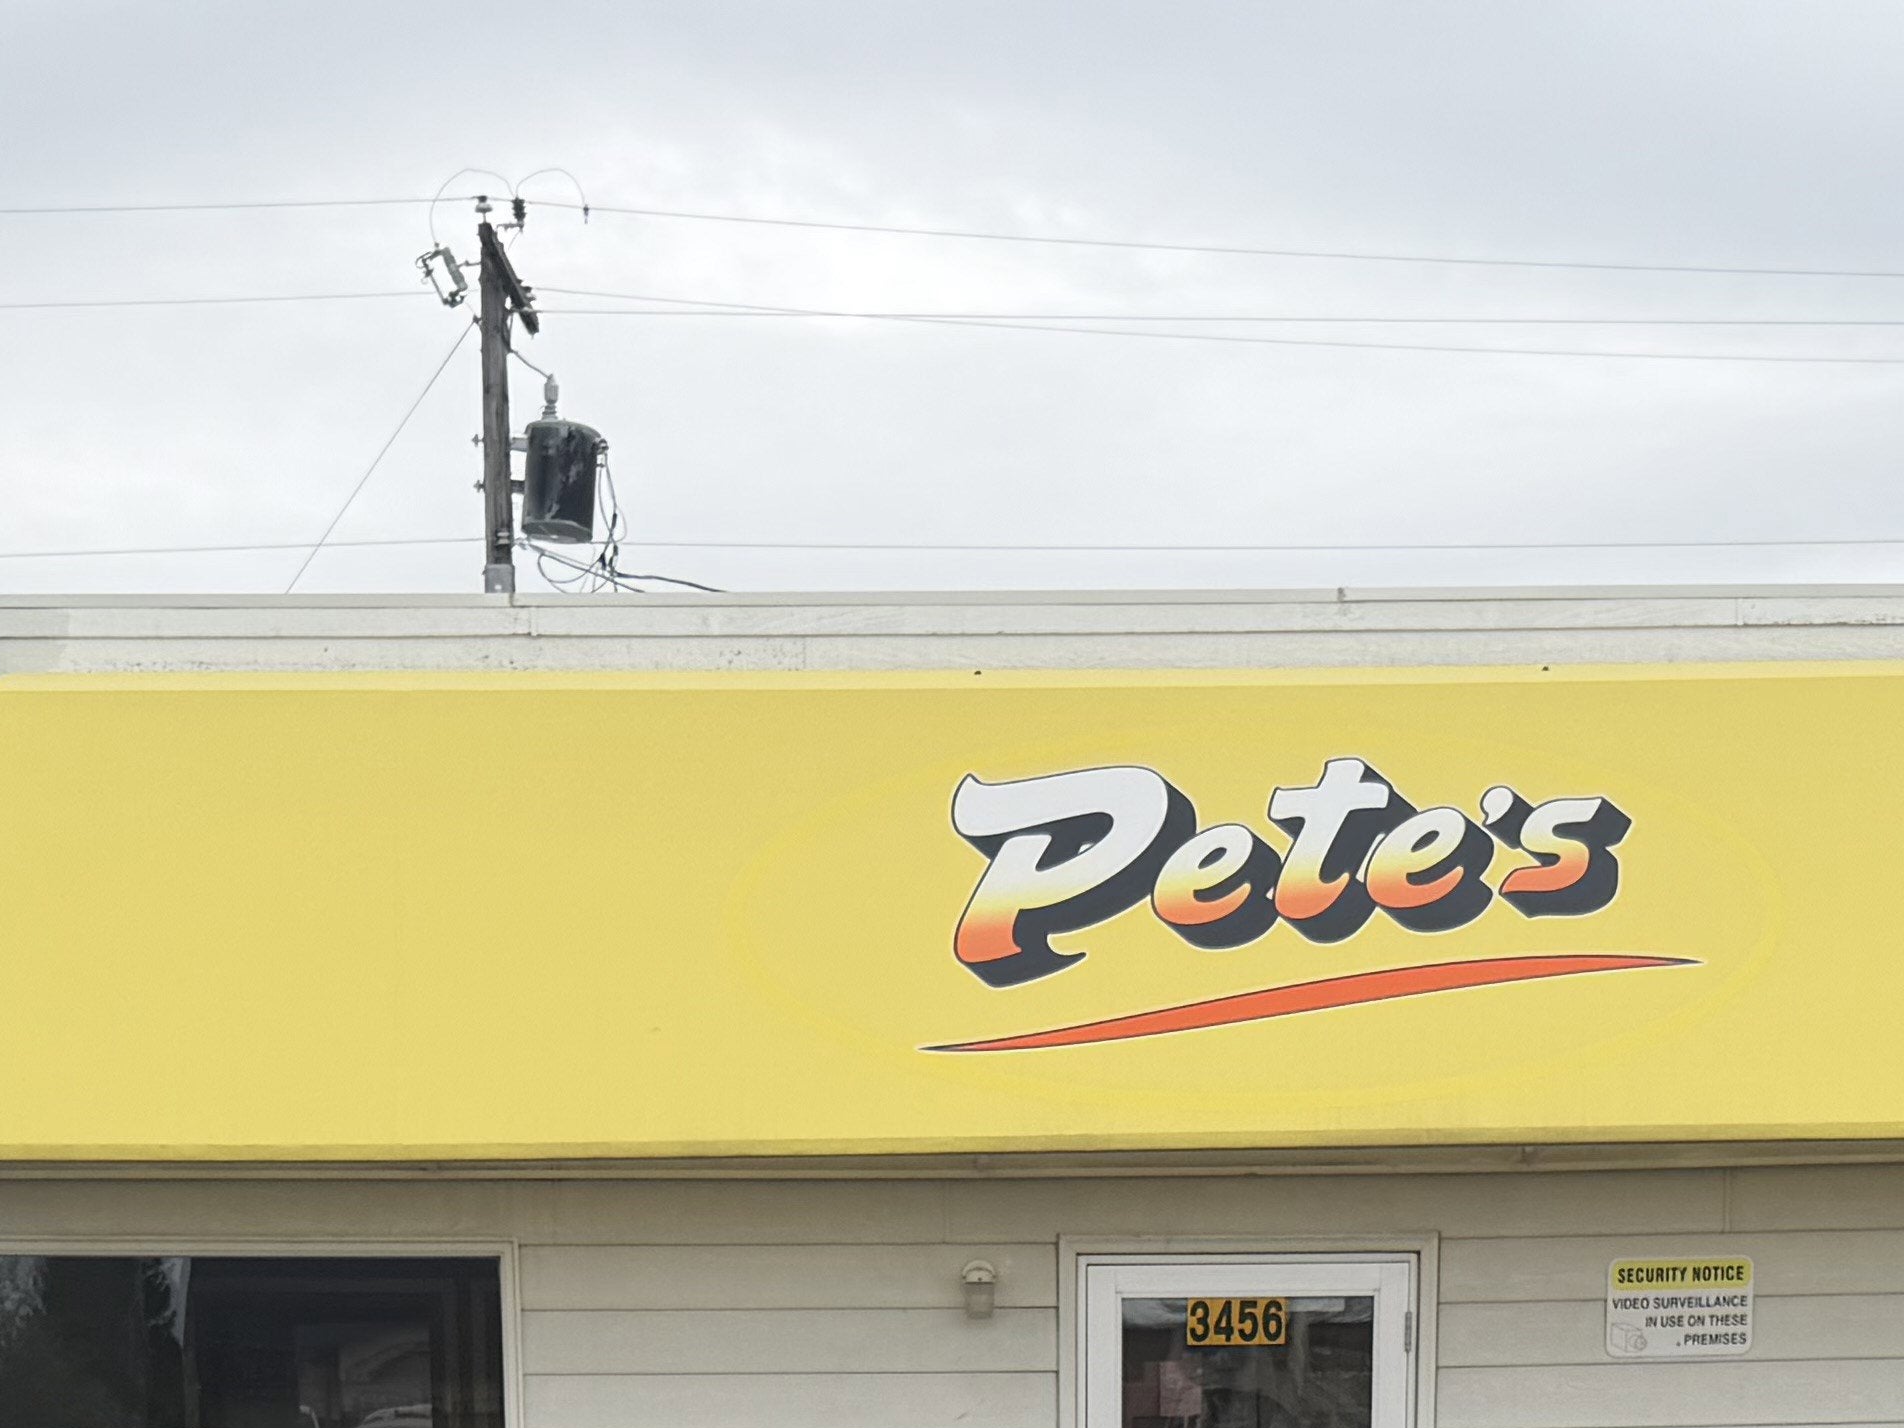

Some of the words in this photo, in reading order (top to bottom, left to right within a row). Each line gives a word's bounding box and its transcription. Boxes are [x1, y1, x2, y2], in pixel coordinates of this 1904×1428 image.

[951, 757, 1632, 988] Pete's
[1617, 1266, 1688, 1284] SECURITY
[1692, 1265, 1745, 1282] NOTICE
[1612, 1297, 1650, 1310] VIDEO
[1653, 1295, 1748, 1309] SURVEILLANCE
[1189, 1300, 1283, 1342] 3456
[1645, 1316, 1658, 1328] IN
[1660, 1315, 1685, 1328] USE
[1687, 1314, 1706, 1327] ON
[1708, 1313, 1748, 1327] THESE
[1684, 1332, 1747, 1346] PREMISES
